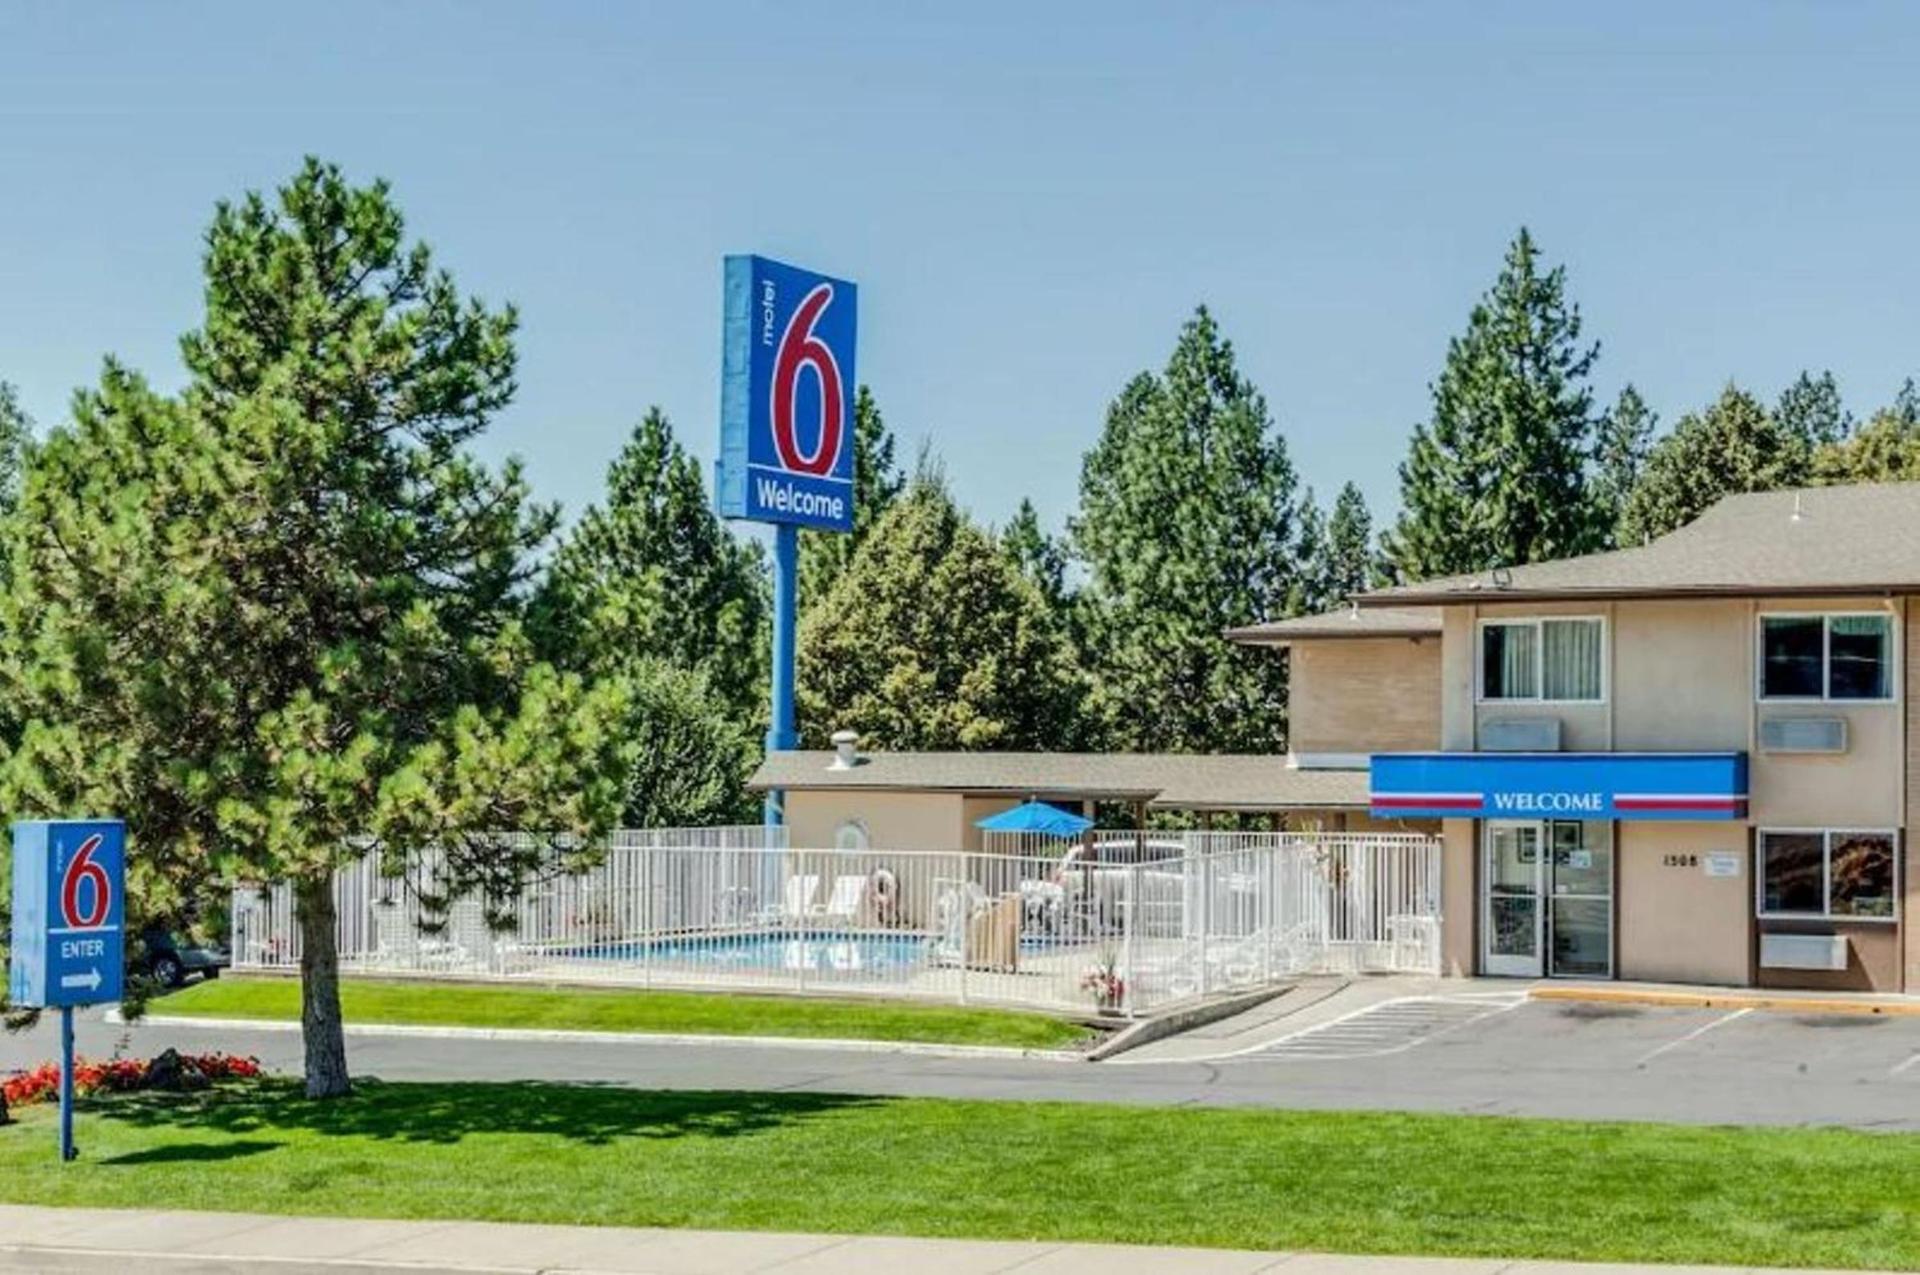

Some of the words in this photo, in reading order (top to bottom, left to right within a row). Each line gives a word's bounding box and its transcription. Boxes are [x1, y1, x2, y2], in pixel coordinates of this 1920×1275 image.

[762, 280, 776, 346] motel
[770, 282, 844, 477] 6
[757, 477, 844, 519] Welcome
[1494, 792, 1603, 811] WELCOME
[61, 833, 111, 931] 6
[61, 939, 105, 959] ENTER
